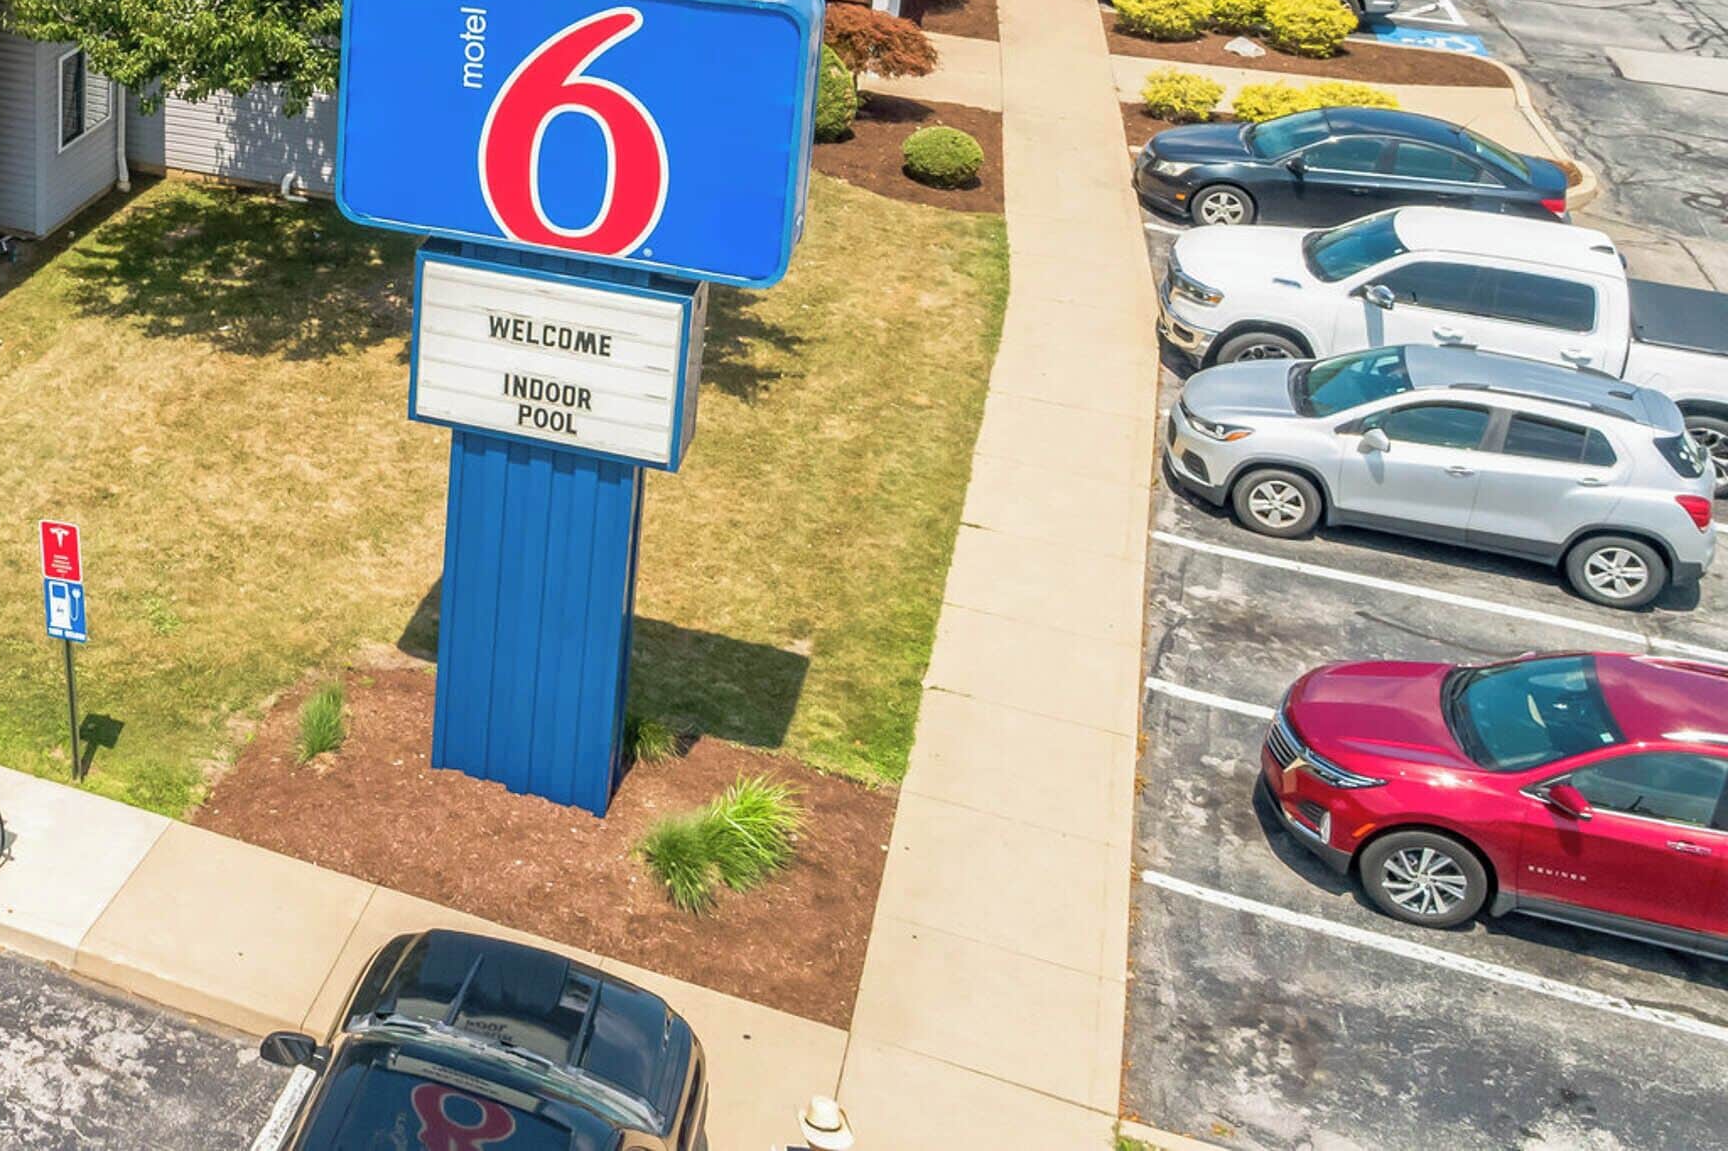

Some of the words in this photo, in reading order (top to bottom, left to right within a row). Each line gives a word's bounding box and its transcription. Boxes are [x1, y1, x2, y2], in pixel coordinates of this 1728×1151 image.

[460, 7, 487, 89] motel
[478, 6, 670, 259] 6
[489, 315, 612, 357] WELCOME
[503, 373, 592, 410] INDOOR
[517, 404, 577, 435] POOL
